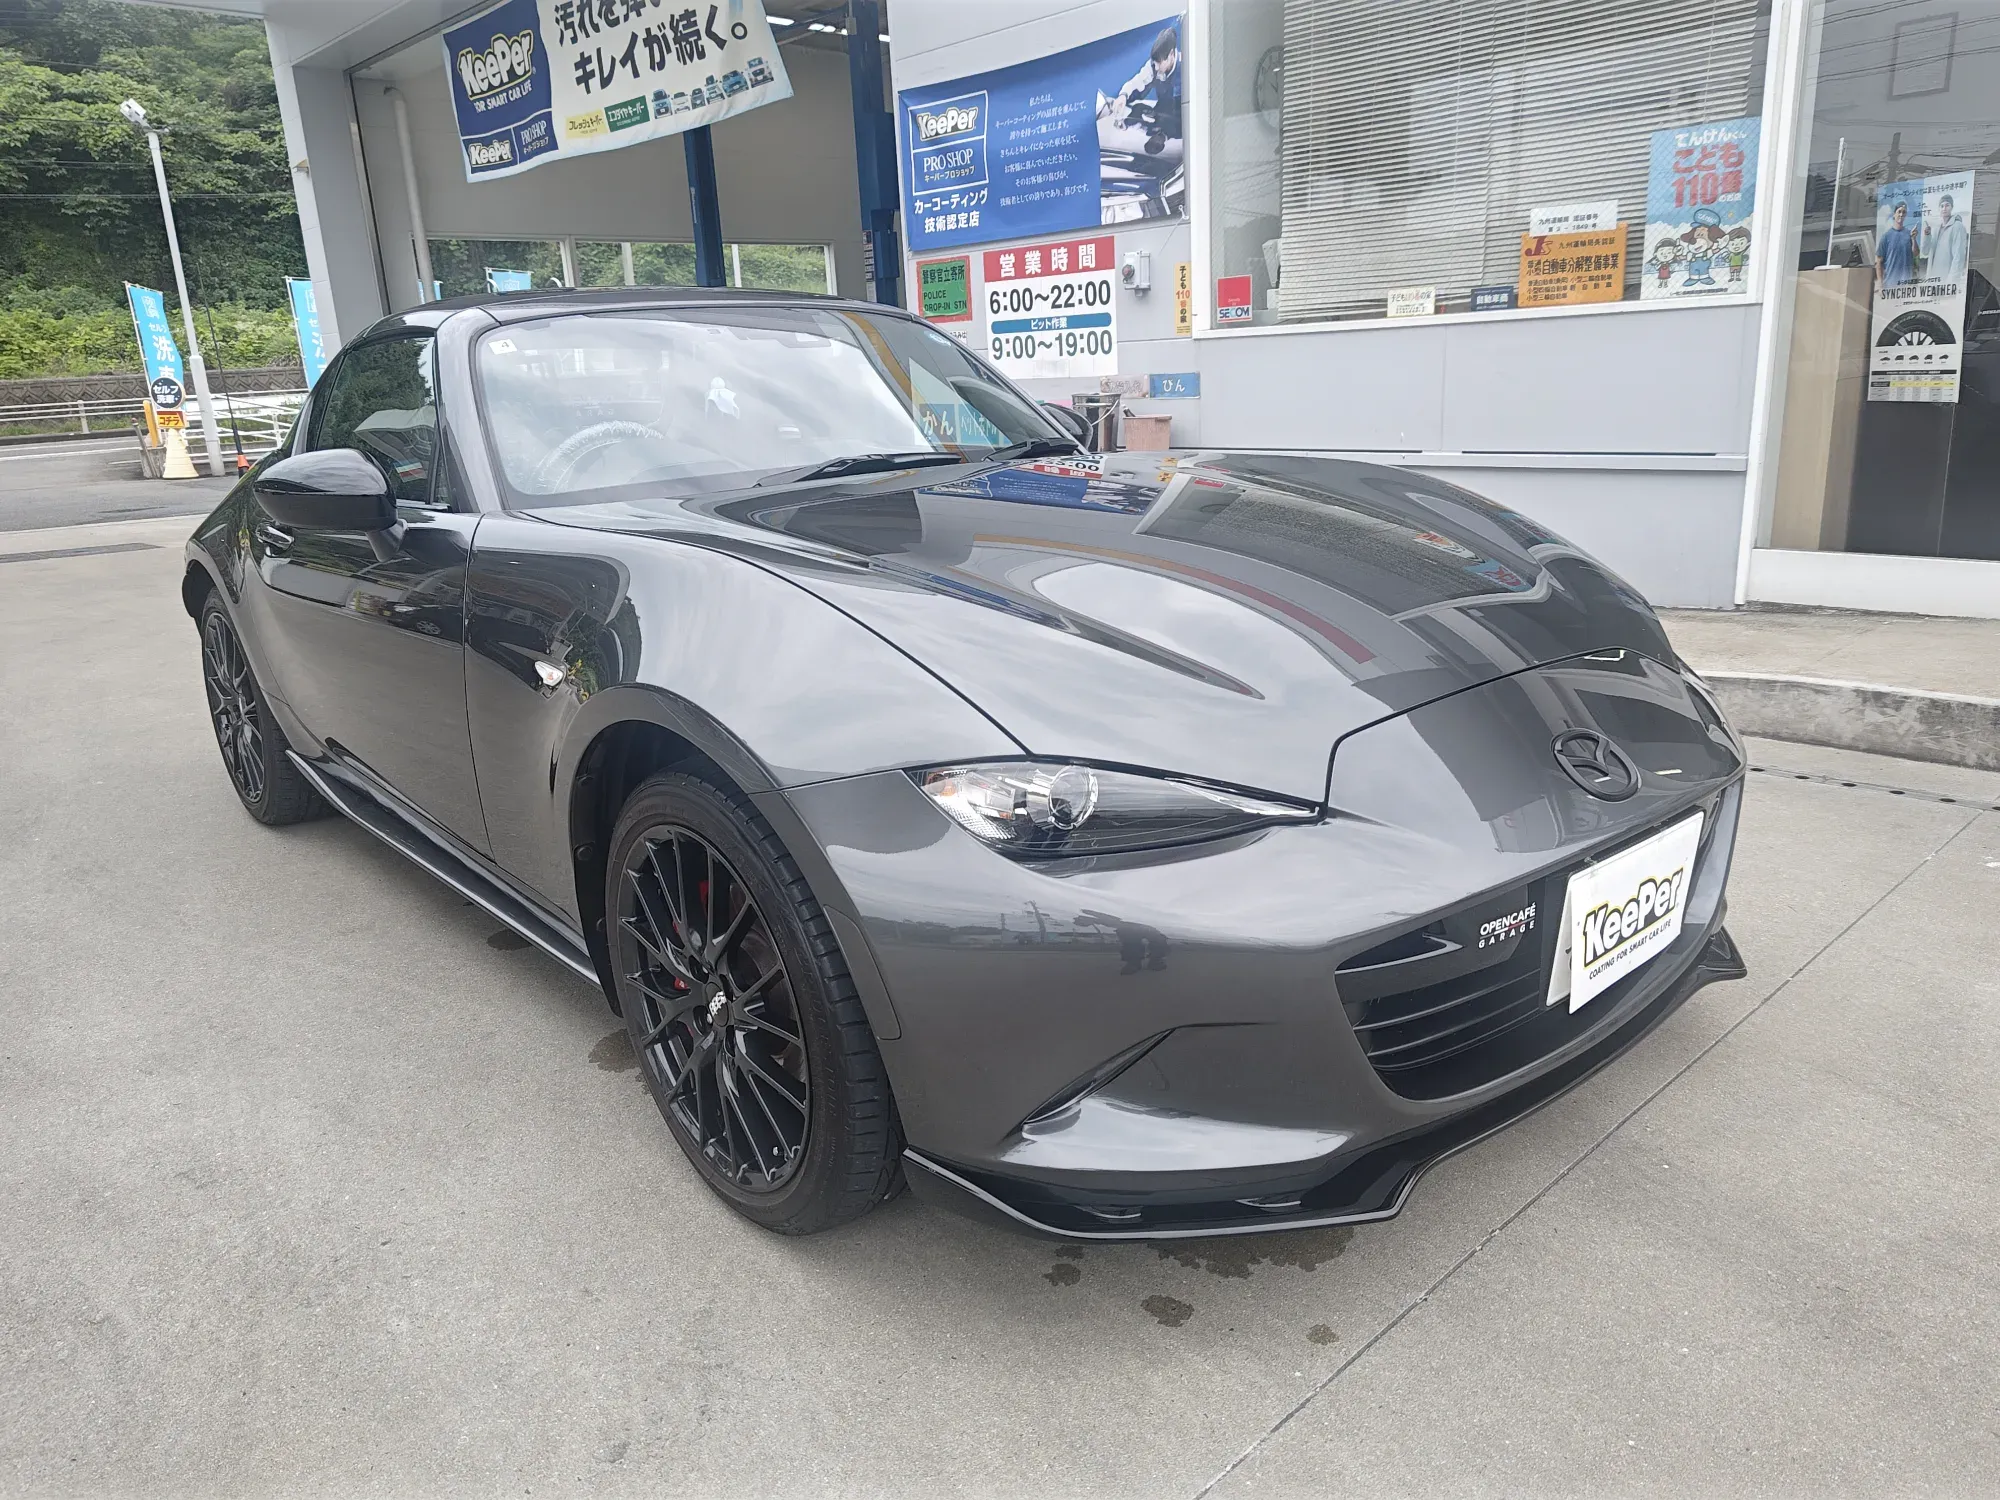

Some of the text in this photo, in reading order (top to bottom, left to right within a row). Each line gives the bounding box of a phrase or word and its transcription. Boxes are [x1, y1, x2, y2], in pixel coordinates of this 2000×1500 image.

[573, 4, 748, 94] キレイが続く。
[458, 31, 533, 99] KeePer
[487, 94, 508, 110] SMART
[508, 88, 522, 102] CAR
[522, 79, 533, 96] LIFE
[917, 107, 978, 141] KeePer
[469, 141, 512, 167] KeePer
[923, 148, 973, 172] PRO SHOP
[1672, 141, 1745, 174] こども
[924, 165, 975, 183] キーパープロショップ
[914, 188, 988, 214] カーコーティング
[1671, 169, 1744, 208] 110番
[924, 210, 980, 233] 技術認定店
[999, 243, 1096, 278] 営業時間
[1542, 252, 1620, 275] 自動車分解整備事業
[922, 265, 965, 285] 警察官立寄所
[923, 290, 947, 300] POLICE
[1881, 284, 1957, 300] SYNCHRO WEATHER
[1030, 317, 1068, 330] ピット作業
[1219, 306, 1250, 319] SECOM
[153, 385, 179, 394] セルフ
[1162, 379, 1186, 392] びん
[158, 416, 180, 426] コチラ
[922, 410, 954, 436] かん
[1480, 902, 1536, 936] OPENCAFÉ
[1583, 867, 1683, 967] KeePer
[1478, 920, 1535, 949] GARAGE
[1589, 918, 1672, 980] COATING FOR SMART CAR LIFE
